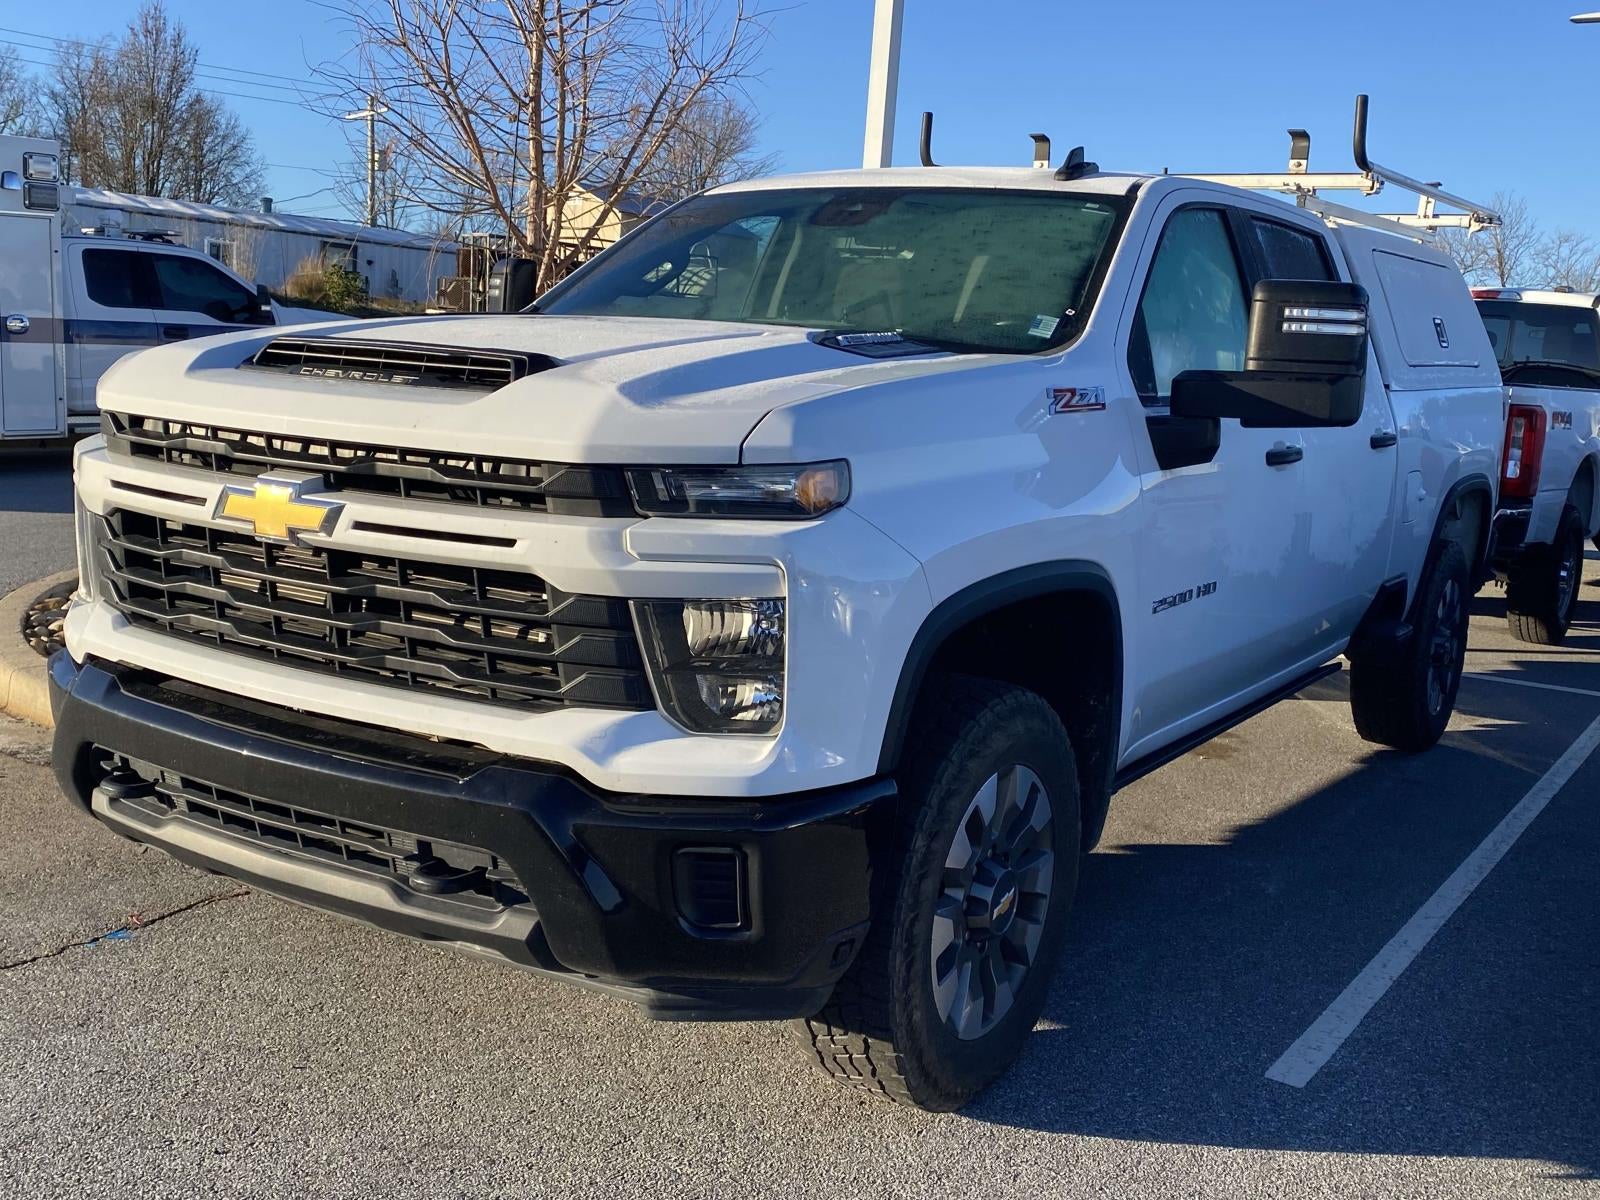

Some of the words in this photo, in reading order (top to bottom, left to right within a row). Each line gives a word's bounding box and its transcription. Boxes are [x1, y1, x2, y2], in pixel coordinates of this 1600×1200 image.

[300, 366, 420, 384] CHEVROLET
[1046, 386, 1106, 415] Z71
[1152, 588, 1193, 614] 2500
[1196, 581, 1217, 599] HD
